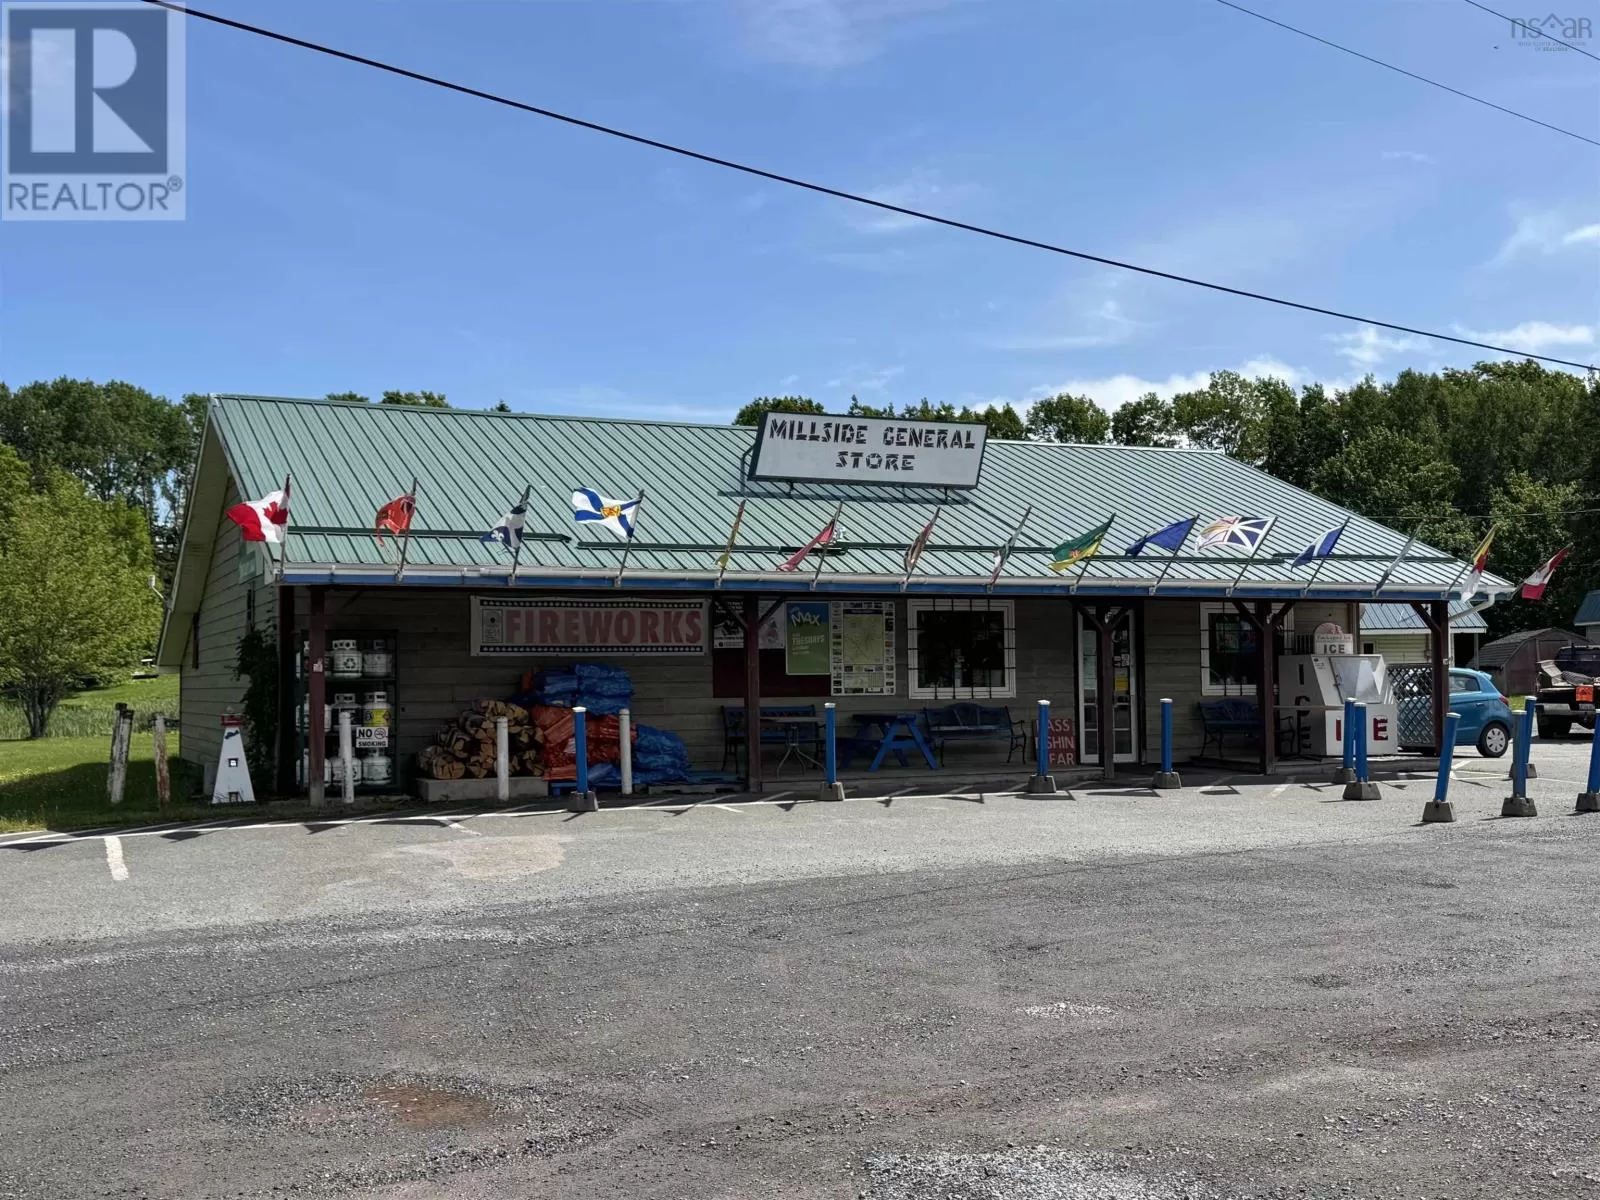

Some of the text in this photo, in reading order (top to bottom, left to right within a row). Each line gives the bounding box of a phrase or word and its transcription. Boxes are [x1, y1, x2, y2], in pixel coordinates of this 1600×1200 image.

[769, 418, 975, 450] MILLSIDE GENERAL
[836, 451, 915, 471] STORE
[505, 610, 701, 644] FIREWORKS
[791, 611, 821, 628] MAX
[1323, 643, 1345, 654] ICE
[358, 728, 373, 738] NO
[1036, 719, 1070, 732] ASS
[1336, 718, 1388, 741] IE
